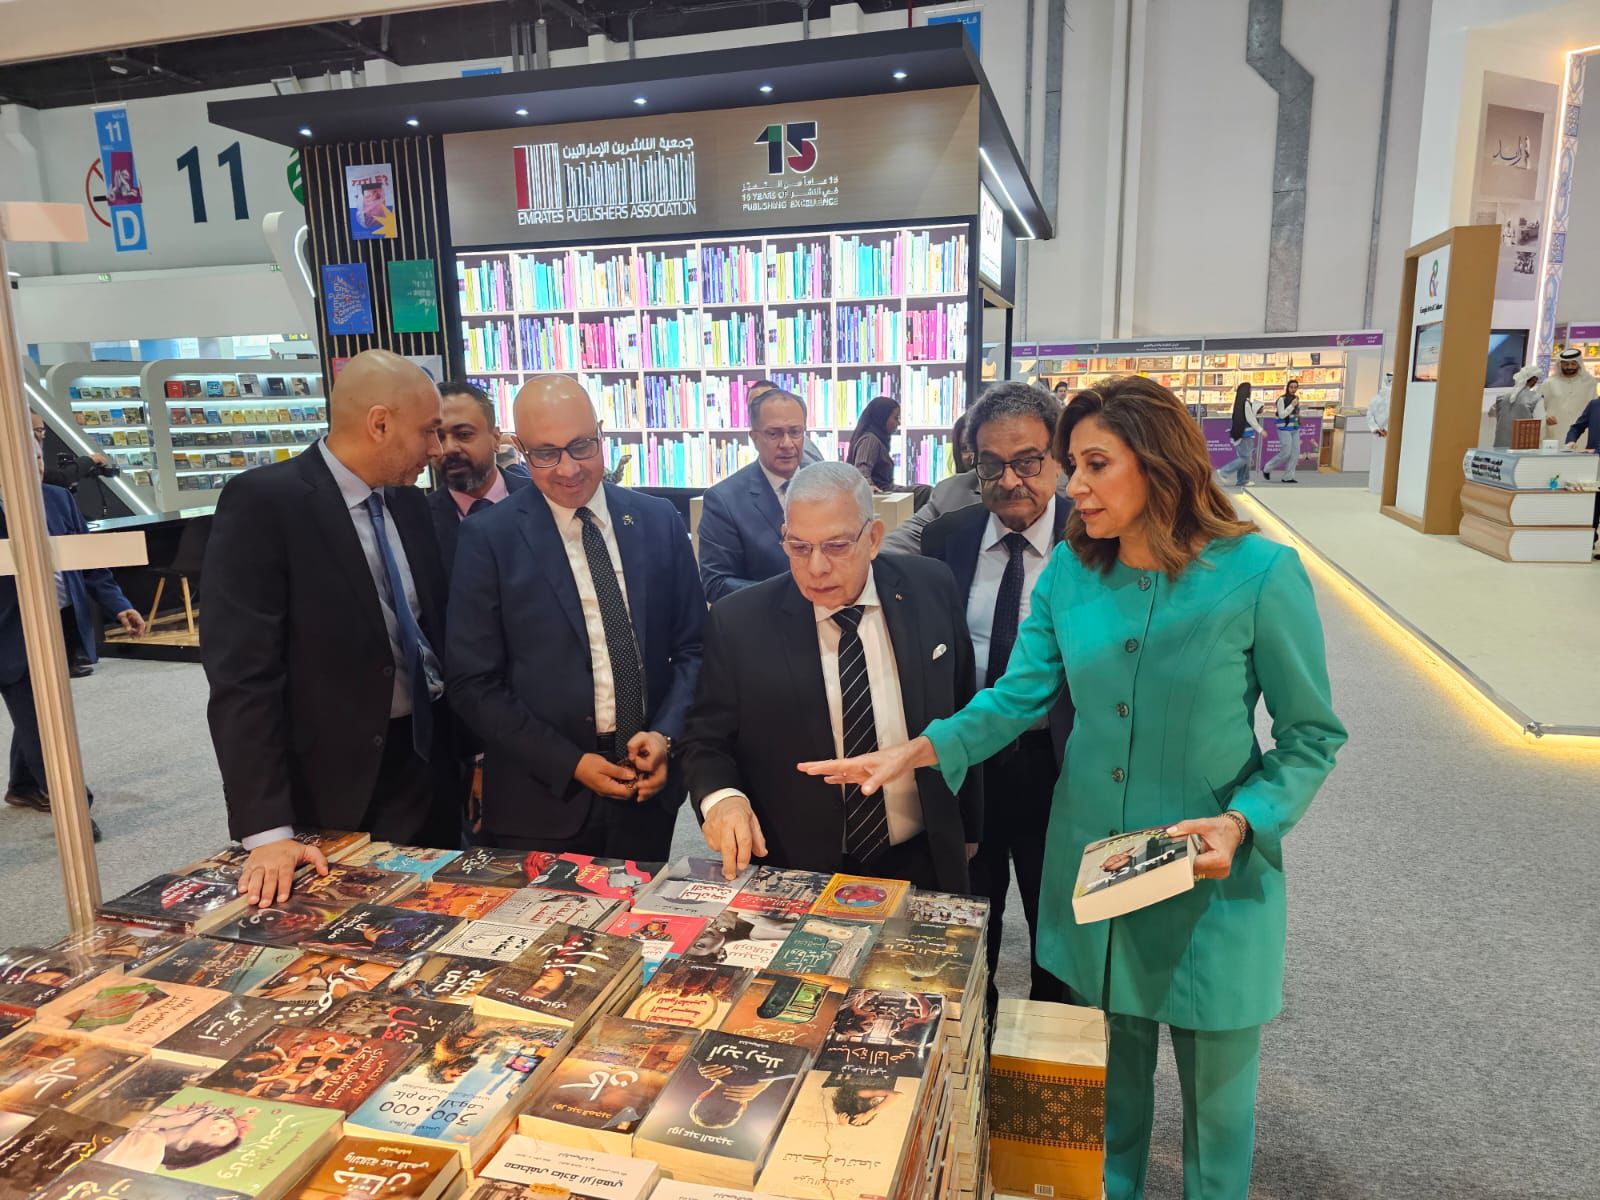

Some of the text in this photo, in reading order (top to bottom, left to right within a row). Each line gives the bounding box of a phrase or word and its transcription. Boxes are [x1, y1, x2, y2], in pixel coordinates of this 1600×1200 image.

[104, 121, 123, 142] 11
[612, 138, 656, 155] الناشرين
[659, 136, 694, 151] جمعية
[753, 120, 818, 176] 15
[176, 140, 249, 223] 11
[517, 201, 697, 225] EMIRATES PUBLISHERS ASSOCIATION
[117, 208, 142, 248] D
[496, 987, 519, 998] عزت
[705, 1046, 744, 1062] أريد
[827, 1044, 917, 1067] سيادة القاضي
[559, 1070, 639, 1102] كان
[391, 1091, 484, 1110] عام من الخوف
[551, 1103, 568, 1112] نور
[667, 1126, 684, 1136] نور
[379, 1158, 399, 1167] عند
[504, 1161, 550, 1175] مصطفى
[551, 1170, 580, 1183] صادق
